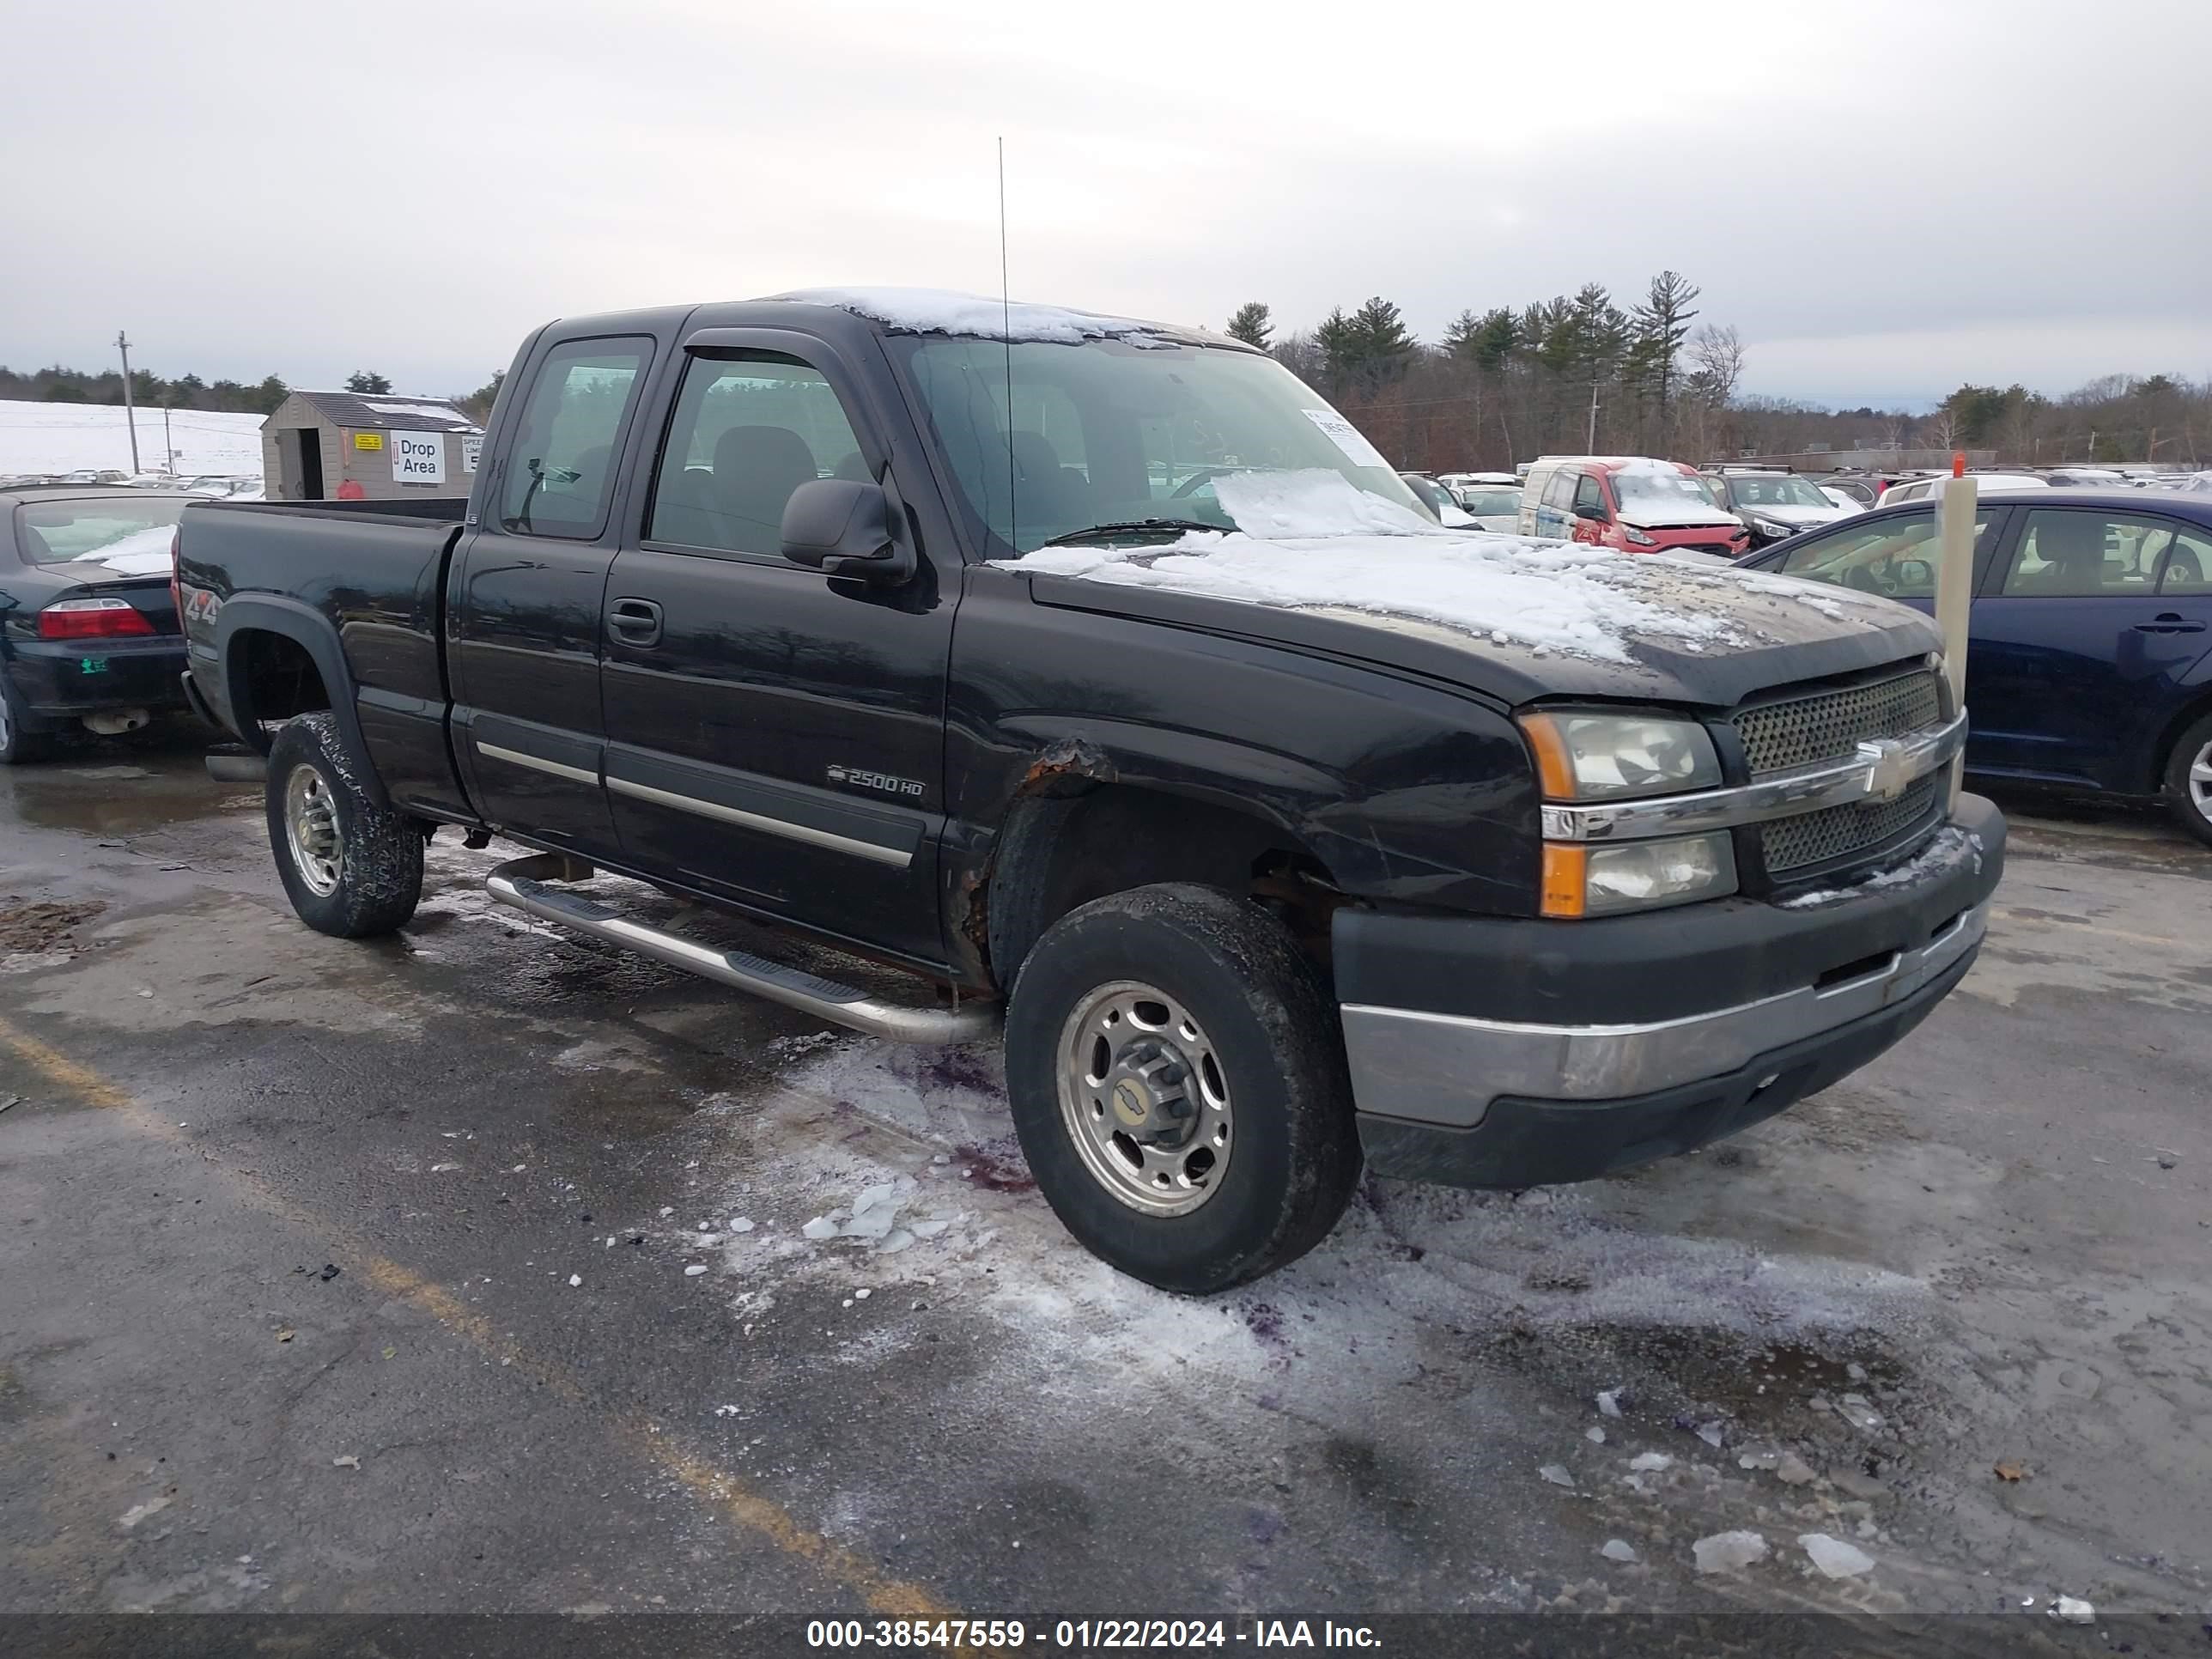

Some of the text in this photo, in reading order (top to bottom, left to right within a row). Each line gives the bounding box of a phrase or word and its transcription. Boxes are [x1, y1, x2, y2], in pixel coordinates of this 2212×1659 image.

[400, 440, 436, 458] Drop
[403, 458, 436, 474] Area
[849, 770, 923, 796] 2500 HD
